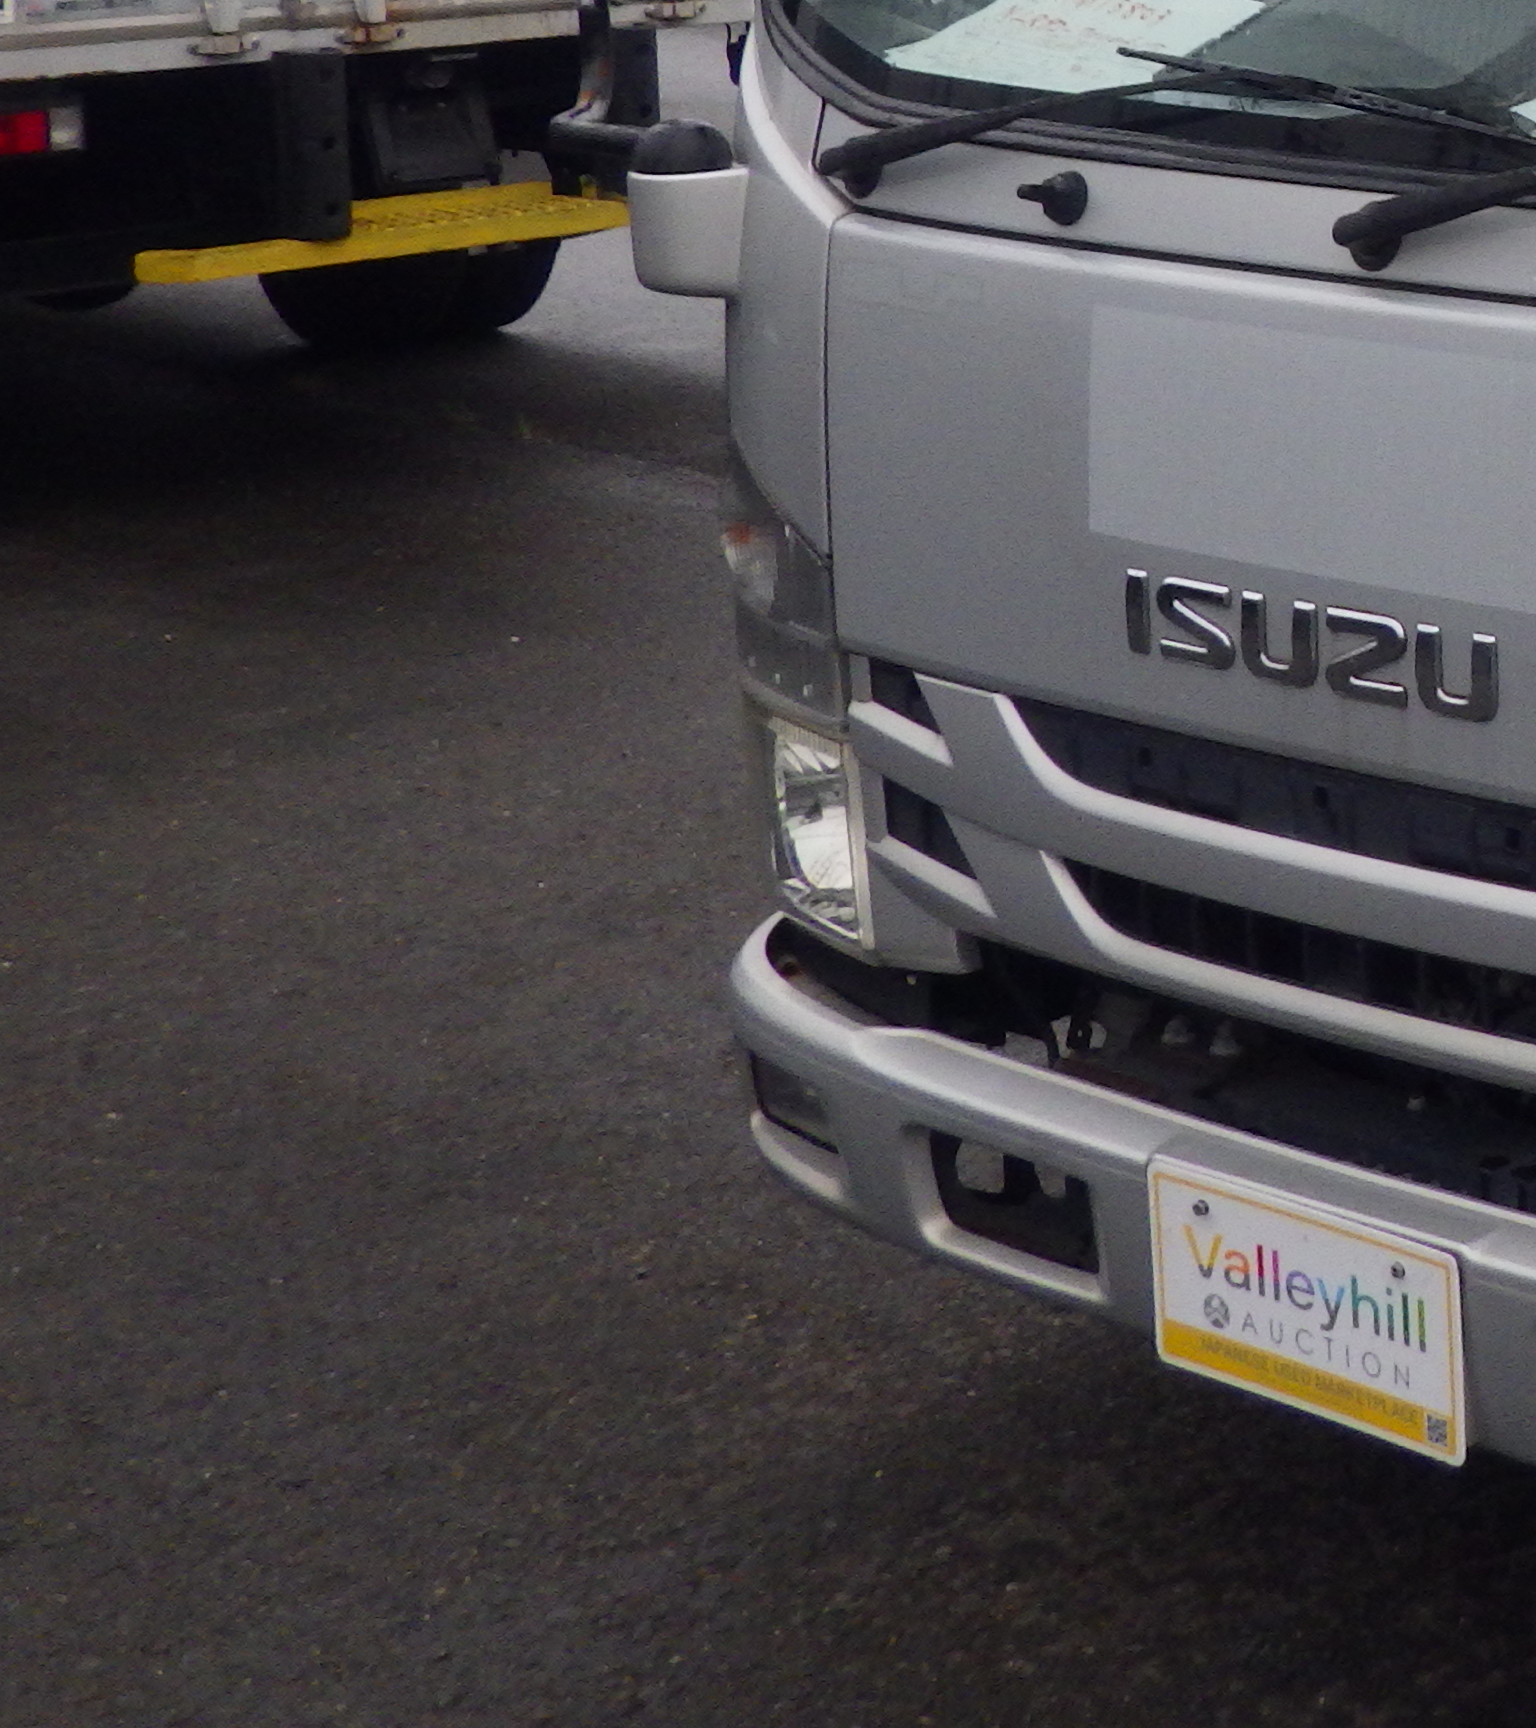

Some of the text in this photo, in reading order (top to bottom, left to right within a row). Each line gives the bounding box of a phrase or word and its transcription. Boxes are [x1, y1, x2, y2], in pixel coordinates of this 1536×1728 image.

[1126, 568, 1499, 722] ISUZU
[1183, 1224, 1426, 1353] Valleyhill
[1241, 1311, 1410, 1389] AUCTION
